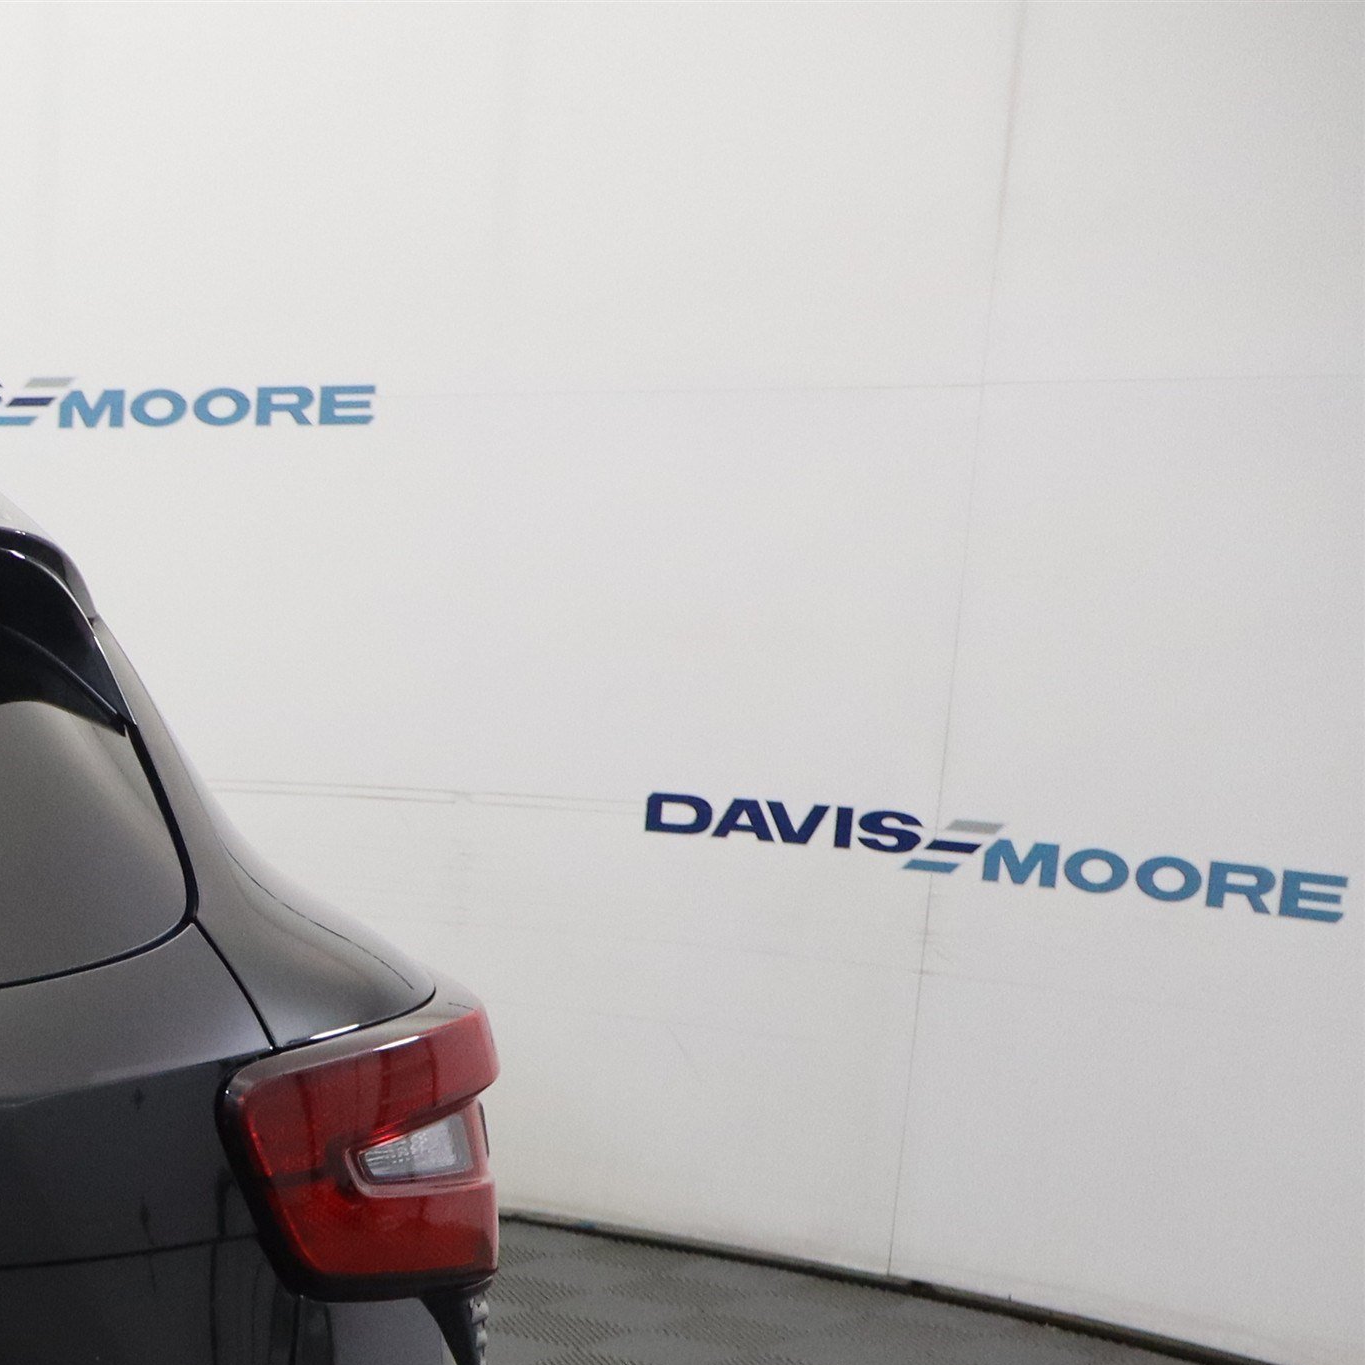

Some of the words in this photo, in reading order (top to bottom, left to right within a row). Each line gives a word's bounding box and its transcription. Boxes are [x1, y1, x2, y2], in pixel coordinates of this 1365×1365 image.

[58, 383, 377, 429] MOORE
[644, 791, 923, 852] DAVIS
[982, 837, 1349, 923] MOORE
